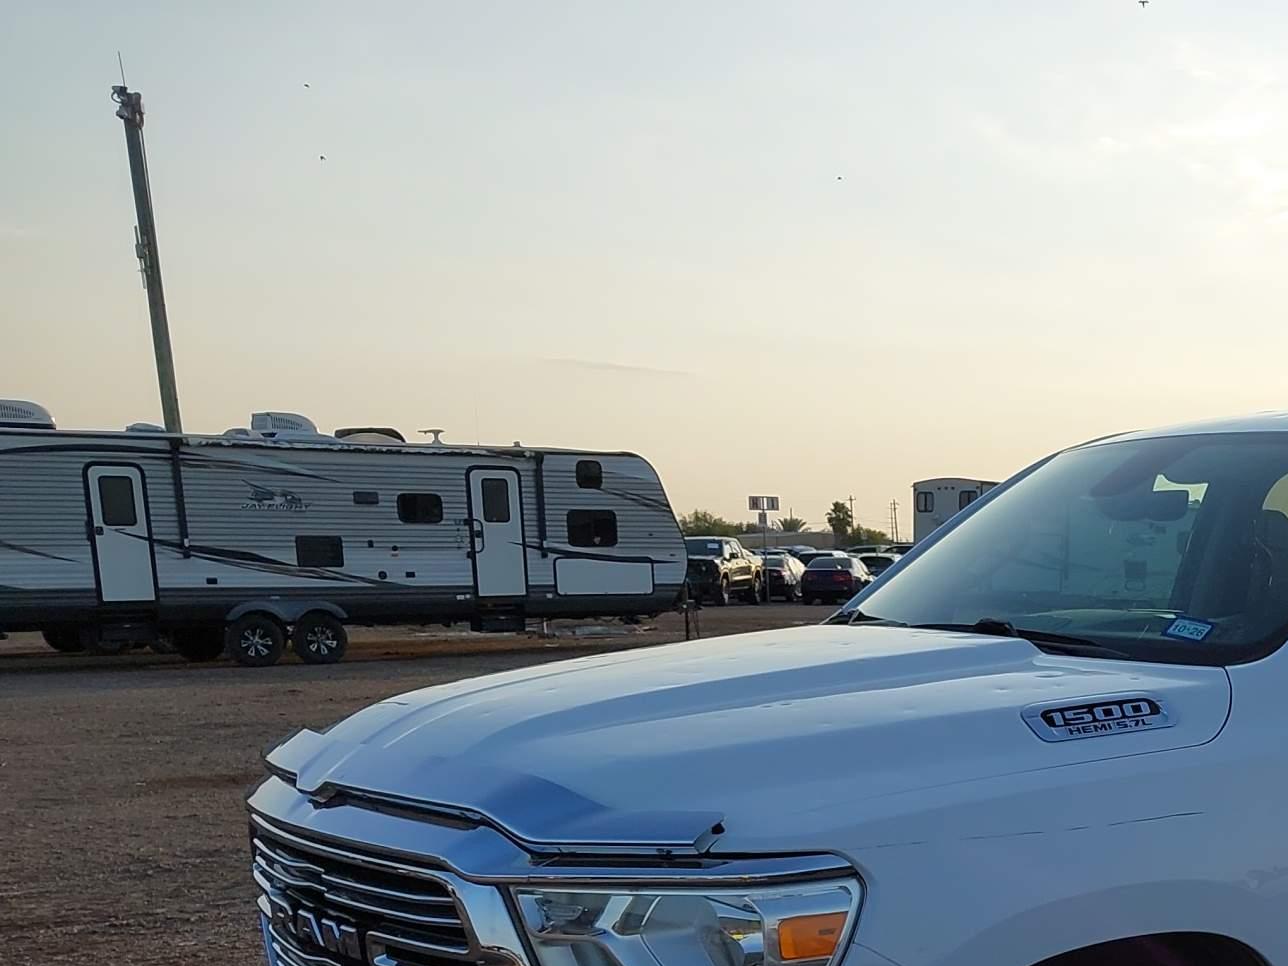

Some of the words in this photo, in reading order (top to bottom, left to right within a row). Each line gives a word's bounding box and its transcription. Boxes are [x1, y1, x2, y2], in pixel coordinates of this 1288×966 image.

[1047, 701, 1151, 726] 1500
[1068, 722, 1112, 736] HEMI
[1117, 719, 1152, 730] 5.7L
[271, 897, 362, 960] RAM
